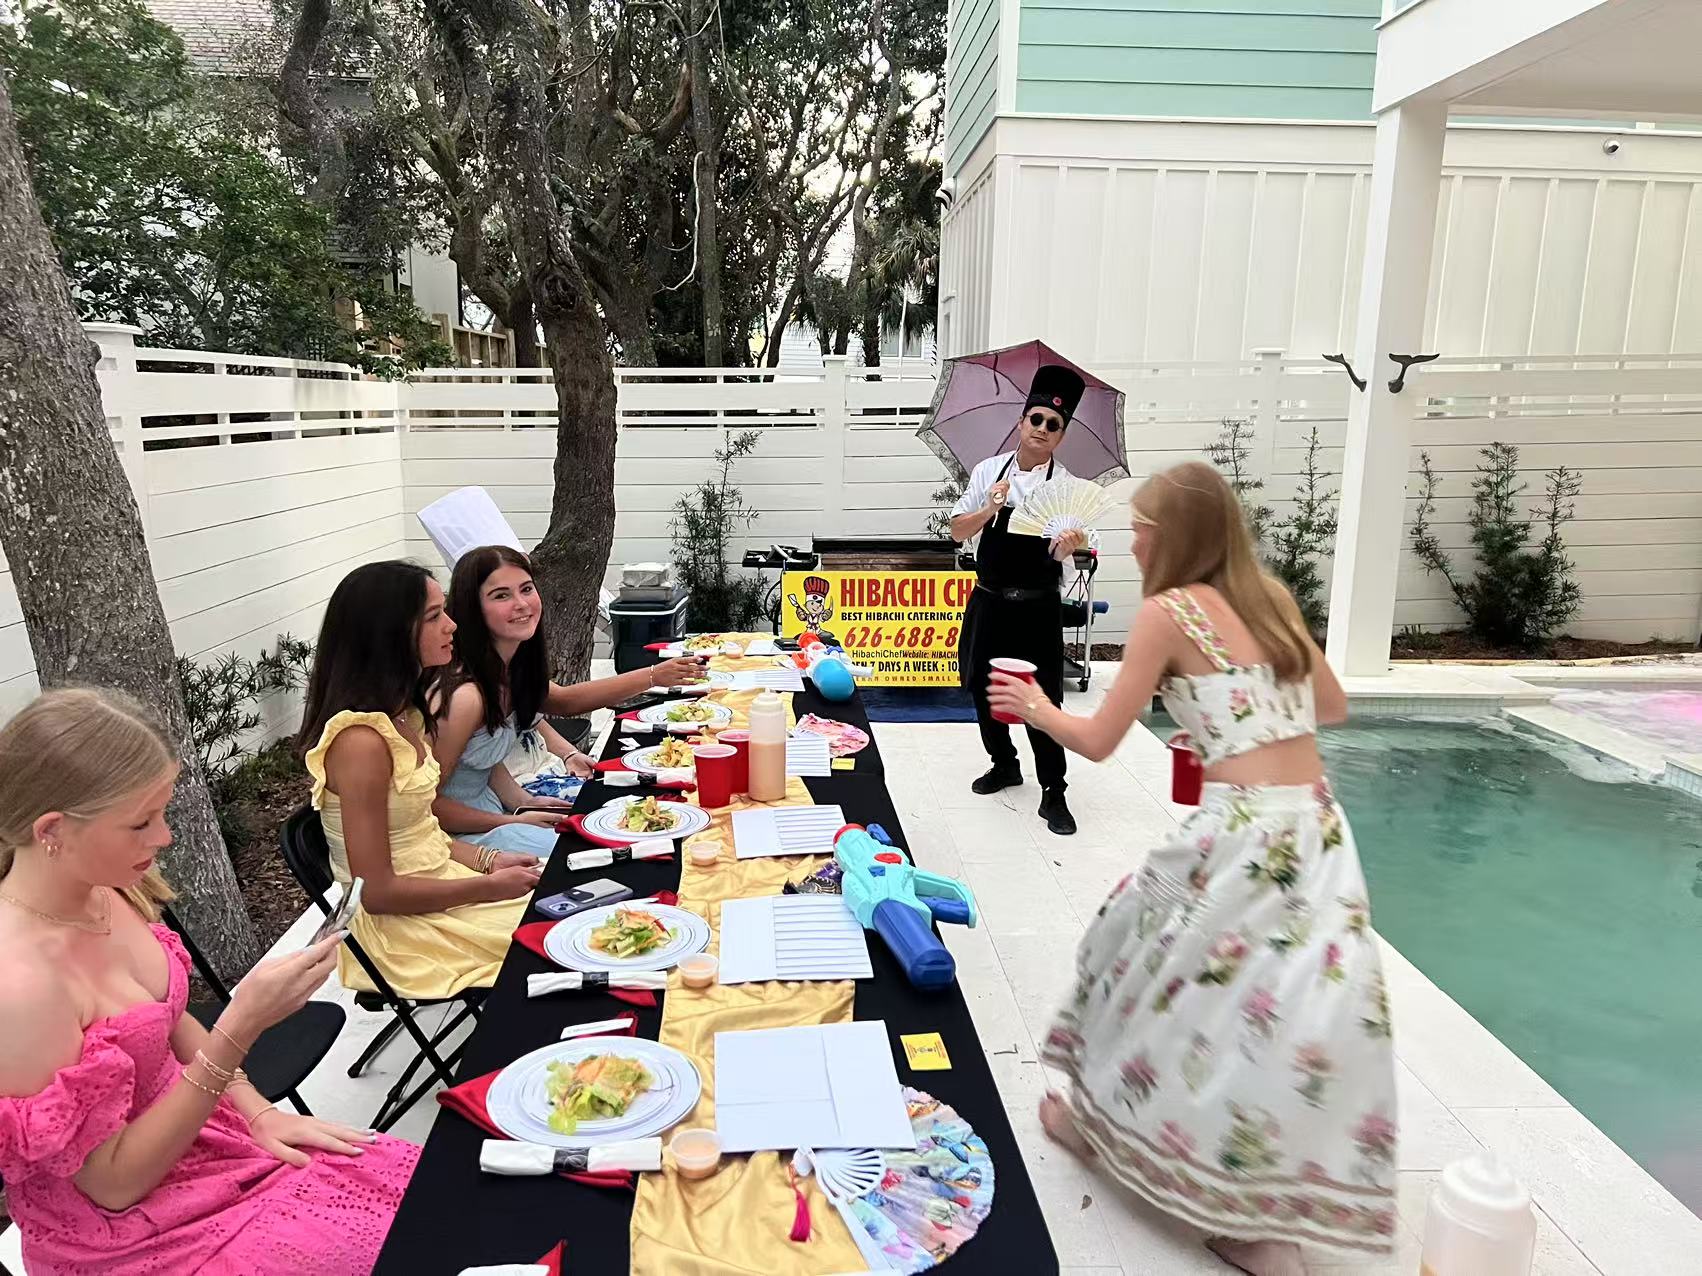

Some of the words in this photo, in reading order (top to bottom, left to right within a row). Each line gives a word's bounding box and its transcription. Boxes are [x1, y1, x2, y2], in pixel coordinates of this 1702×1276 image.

[841, 579, 935, 607] HIBACHI
[943, 579, 975, 607] CH
[841, 612, 863, 621] BEST
[866, 612, 905, 621] HIBACHI
[907, 612, 953, 621] CATERING
[844, 626, 959, 648] 626-688-8
[878, 661, 901, 672] DAYS
[904, 661, 911, 672] A
[913, 661, 939, 672] WEEK
[947, 661, 960, 672] 10
